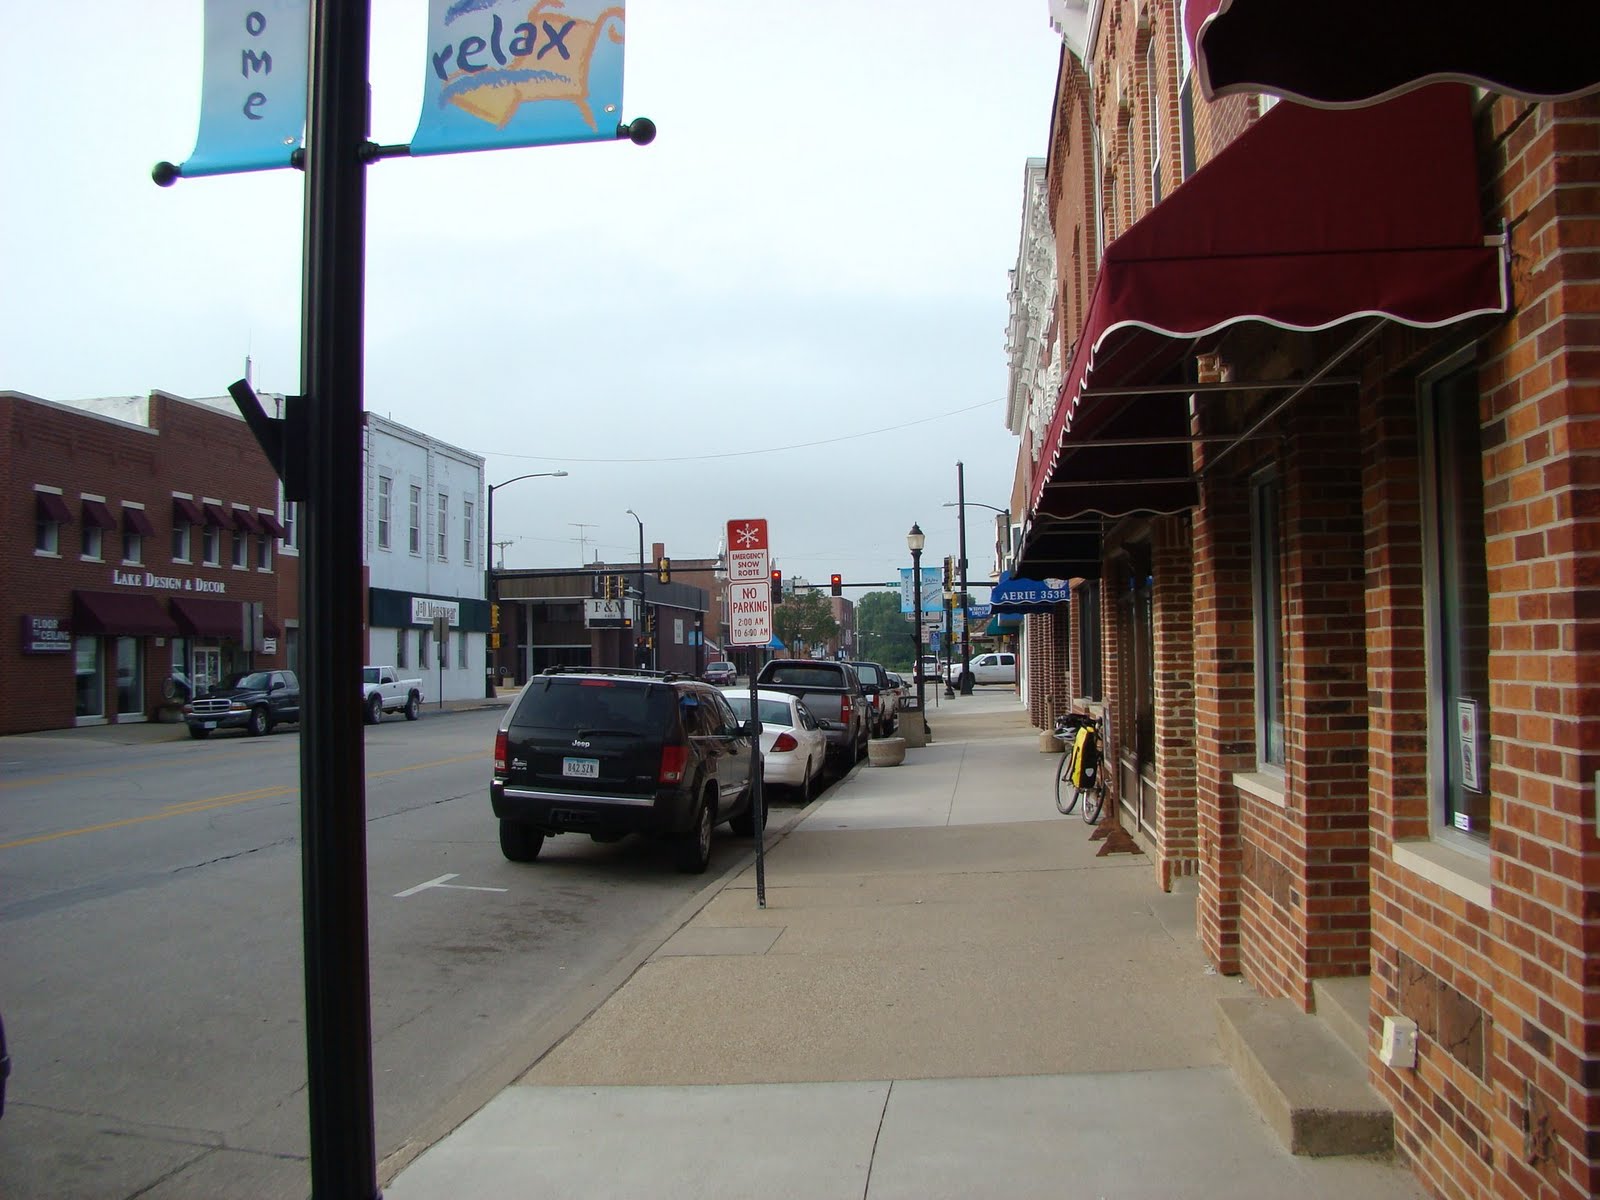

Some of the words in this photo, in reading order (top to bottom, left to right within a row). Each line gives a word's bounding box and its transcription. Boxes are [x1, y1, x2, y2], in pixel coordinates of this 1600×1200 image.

[432, 13, 577, 81] relax
[733, 552, 764, 560] EMERGENCY
[738, 561, 760, 569] SNOW
[738, 569, 760, 577] ROUTE
[185, 579, 192, 590] &
[742, 587, 757, 600] NO
[1000, 590, 1036, 600] AERIE
[1040, 589, 1066, 599] 3538
[733, 600, 768, 613] PARKING
[32, 618, 59, 629] FLOOR
[738, 618, 753, 627] 2:00
[755, 617, 764, 625] AM
[41, 630, 71, 641] CEILING
[734, 630, 741, 638] TO
[744, 628, 757, 637] 6:00
[760, 627, 769, 636] AM
[571, 739, 591, 748] Jeep
